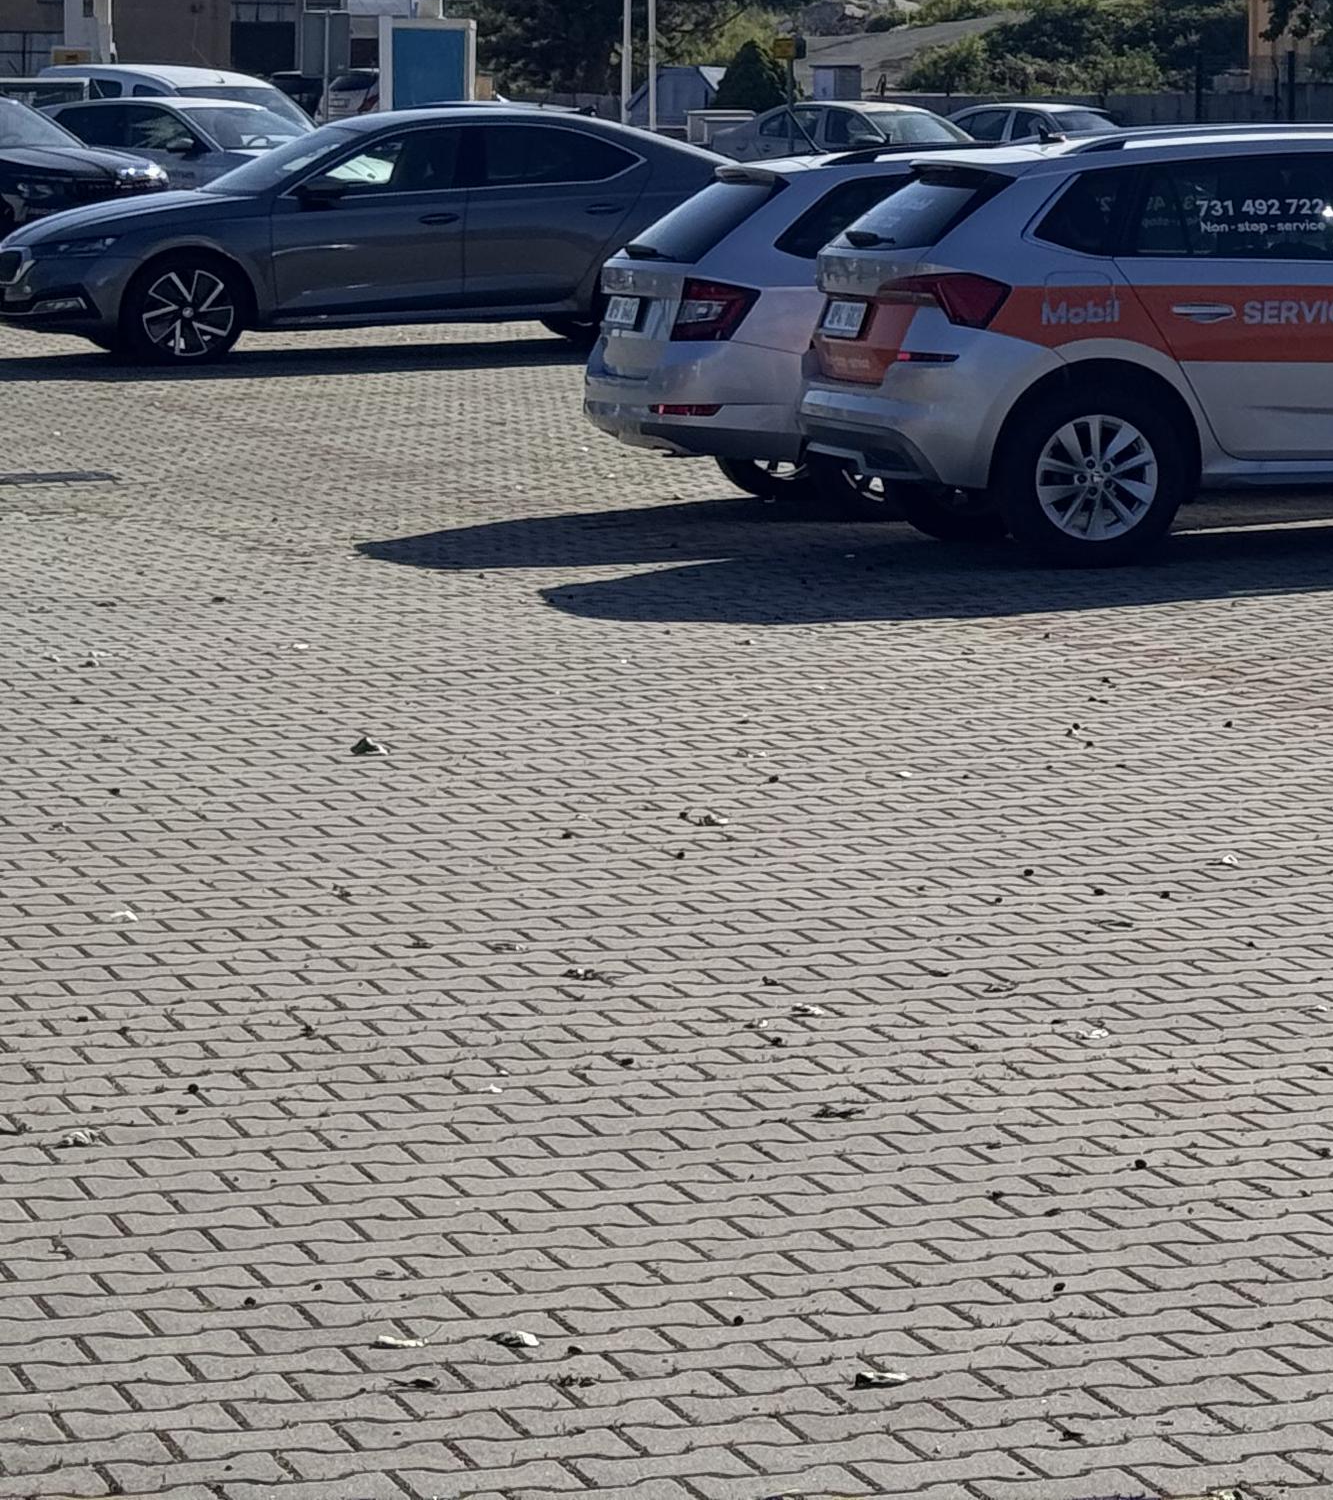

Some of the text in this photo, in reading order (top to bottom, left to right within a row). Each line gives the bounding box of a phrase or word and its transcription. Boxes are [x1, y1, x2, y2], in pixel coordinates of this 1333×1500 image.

[1195, 199, 1235, 216] 731
[1241, 198, 1281, 216] 492
[1285, 198, 1324, 215] 722
[1041, 301, 1120, 326] Mobil
